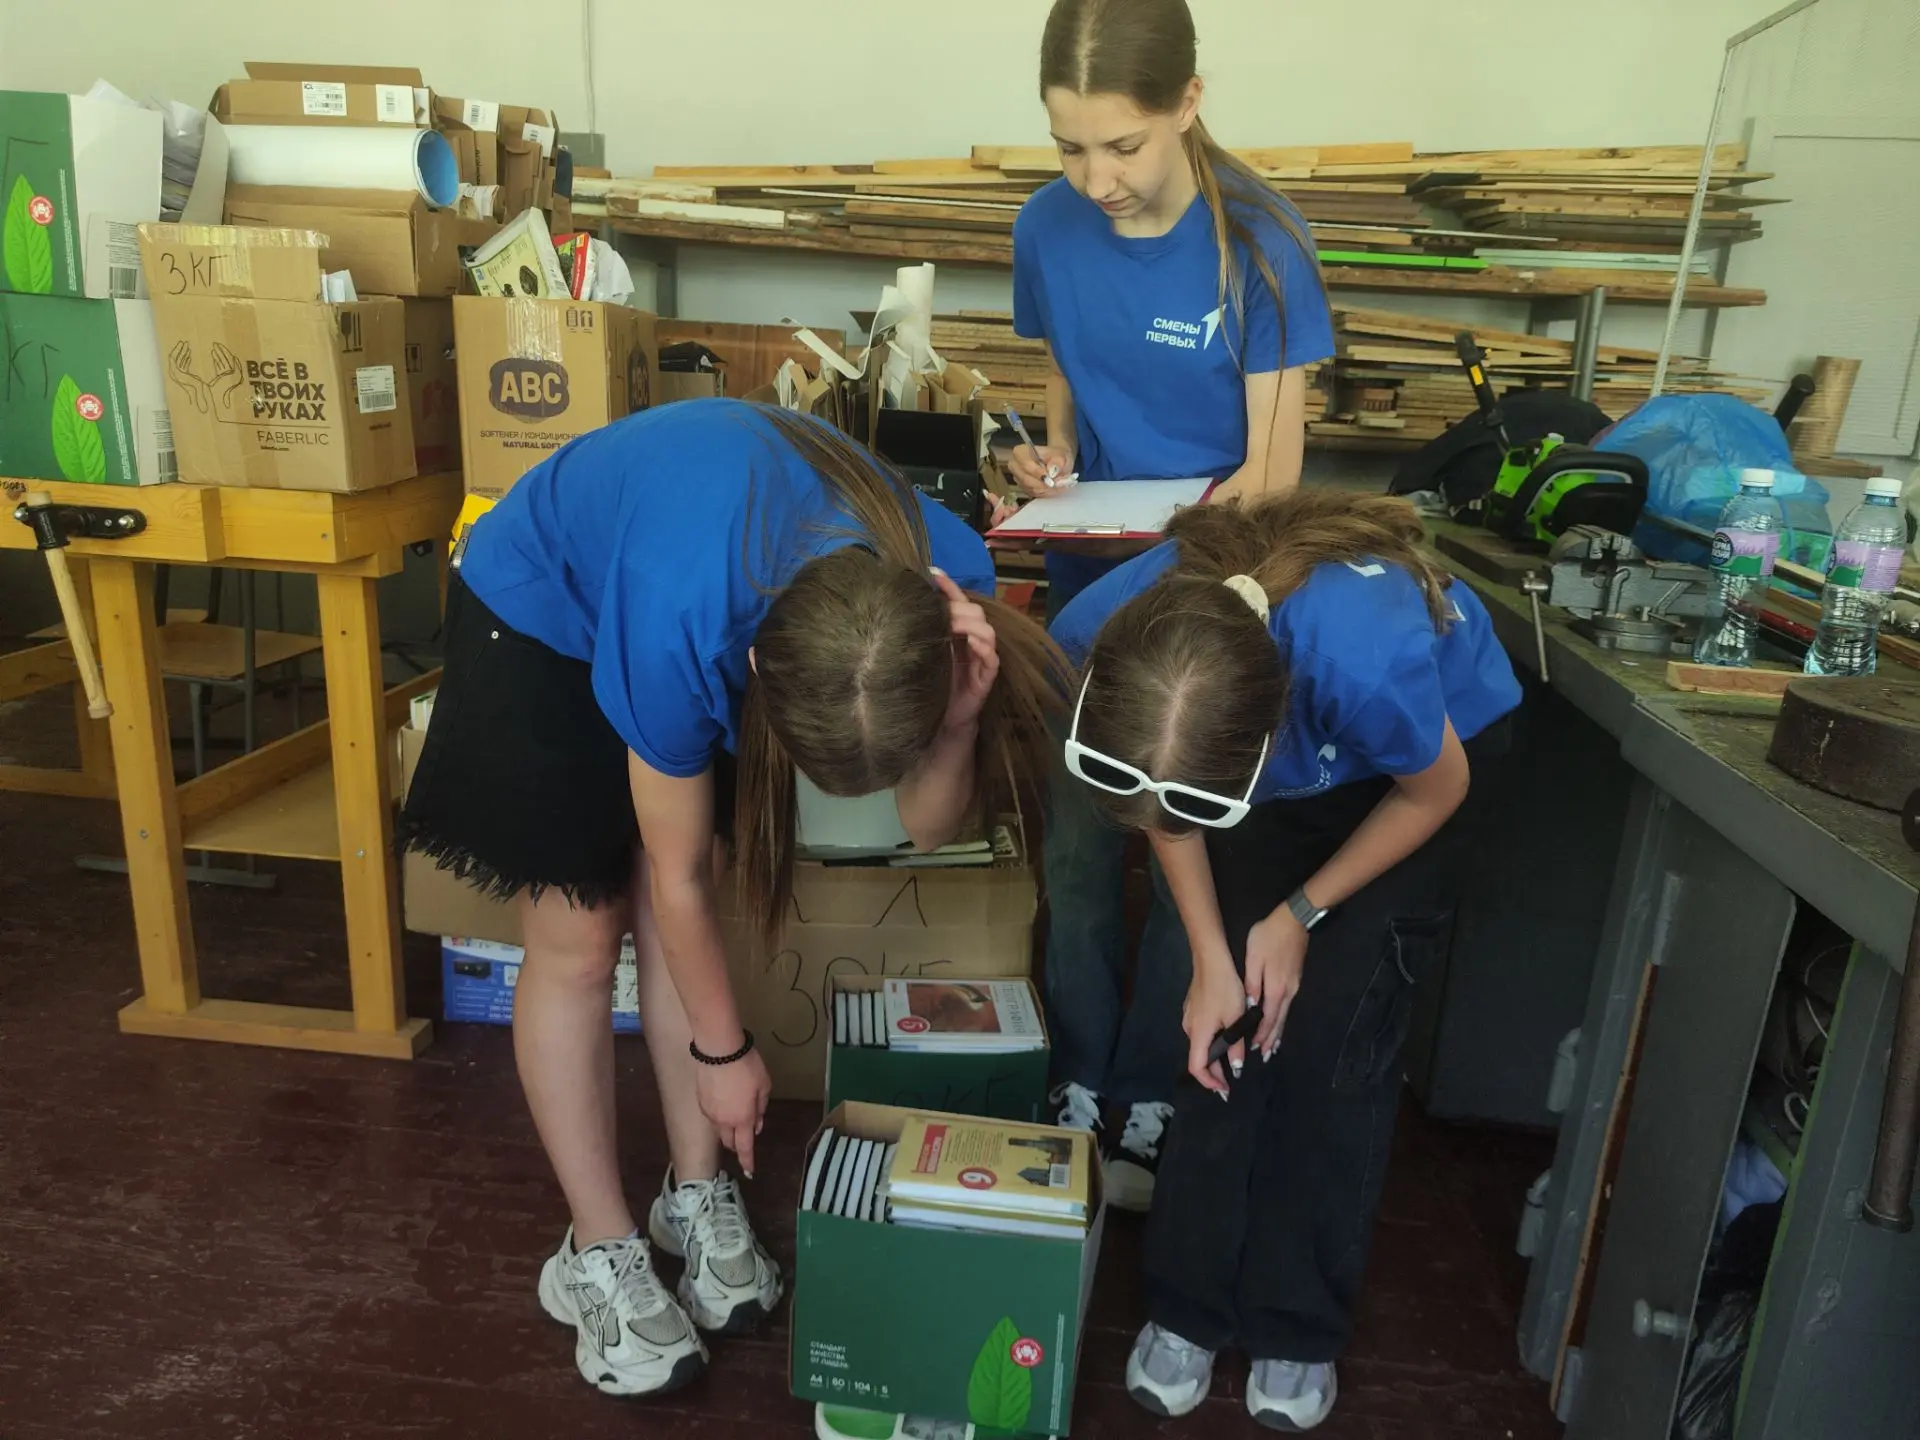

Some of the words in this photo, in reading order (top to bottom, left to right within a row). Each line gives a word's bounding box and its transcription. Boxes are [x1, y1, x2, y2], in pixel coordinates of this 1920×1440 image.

[161, 252, 188, 295] 3
[1153, 317, 1201, 335] СМЕНЫ
[1145, 330, 1197, 350] ПЕРВЫХ
[246, 357, 290, 381] ВСЁ
[293, 361, 309, 381] В
[249, 381, 327, 401] ТВОИХ
[500, 370, 563, 405] ABC
[252, 400, 327, 422] РУКАХ
[256, 429, 330, 446] FABERLIC
[480, 430, 519, 439] SOFTENER
[503, 440, 540, 449] NATURAL
[854, 1380, 871, 1392] 104
